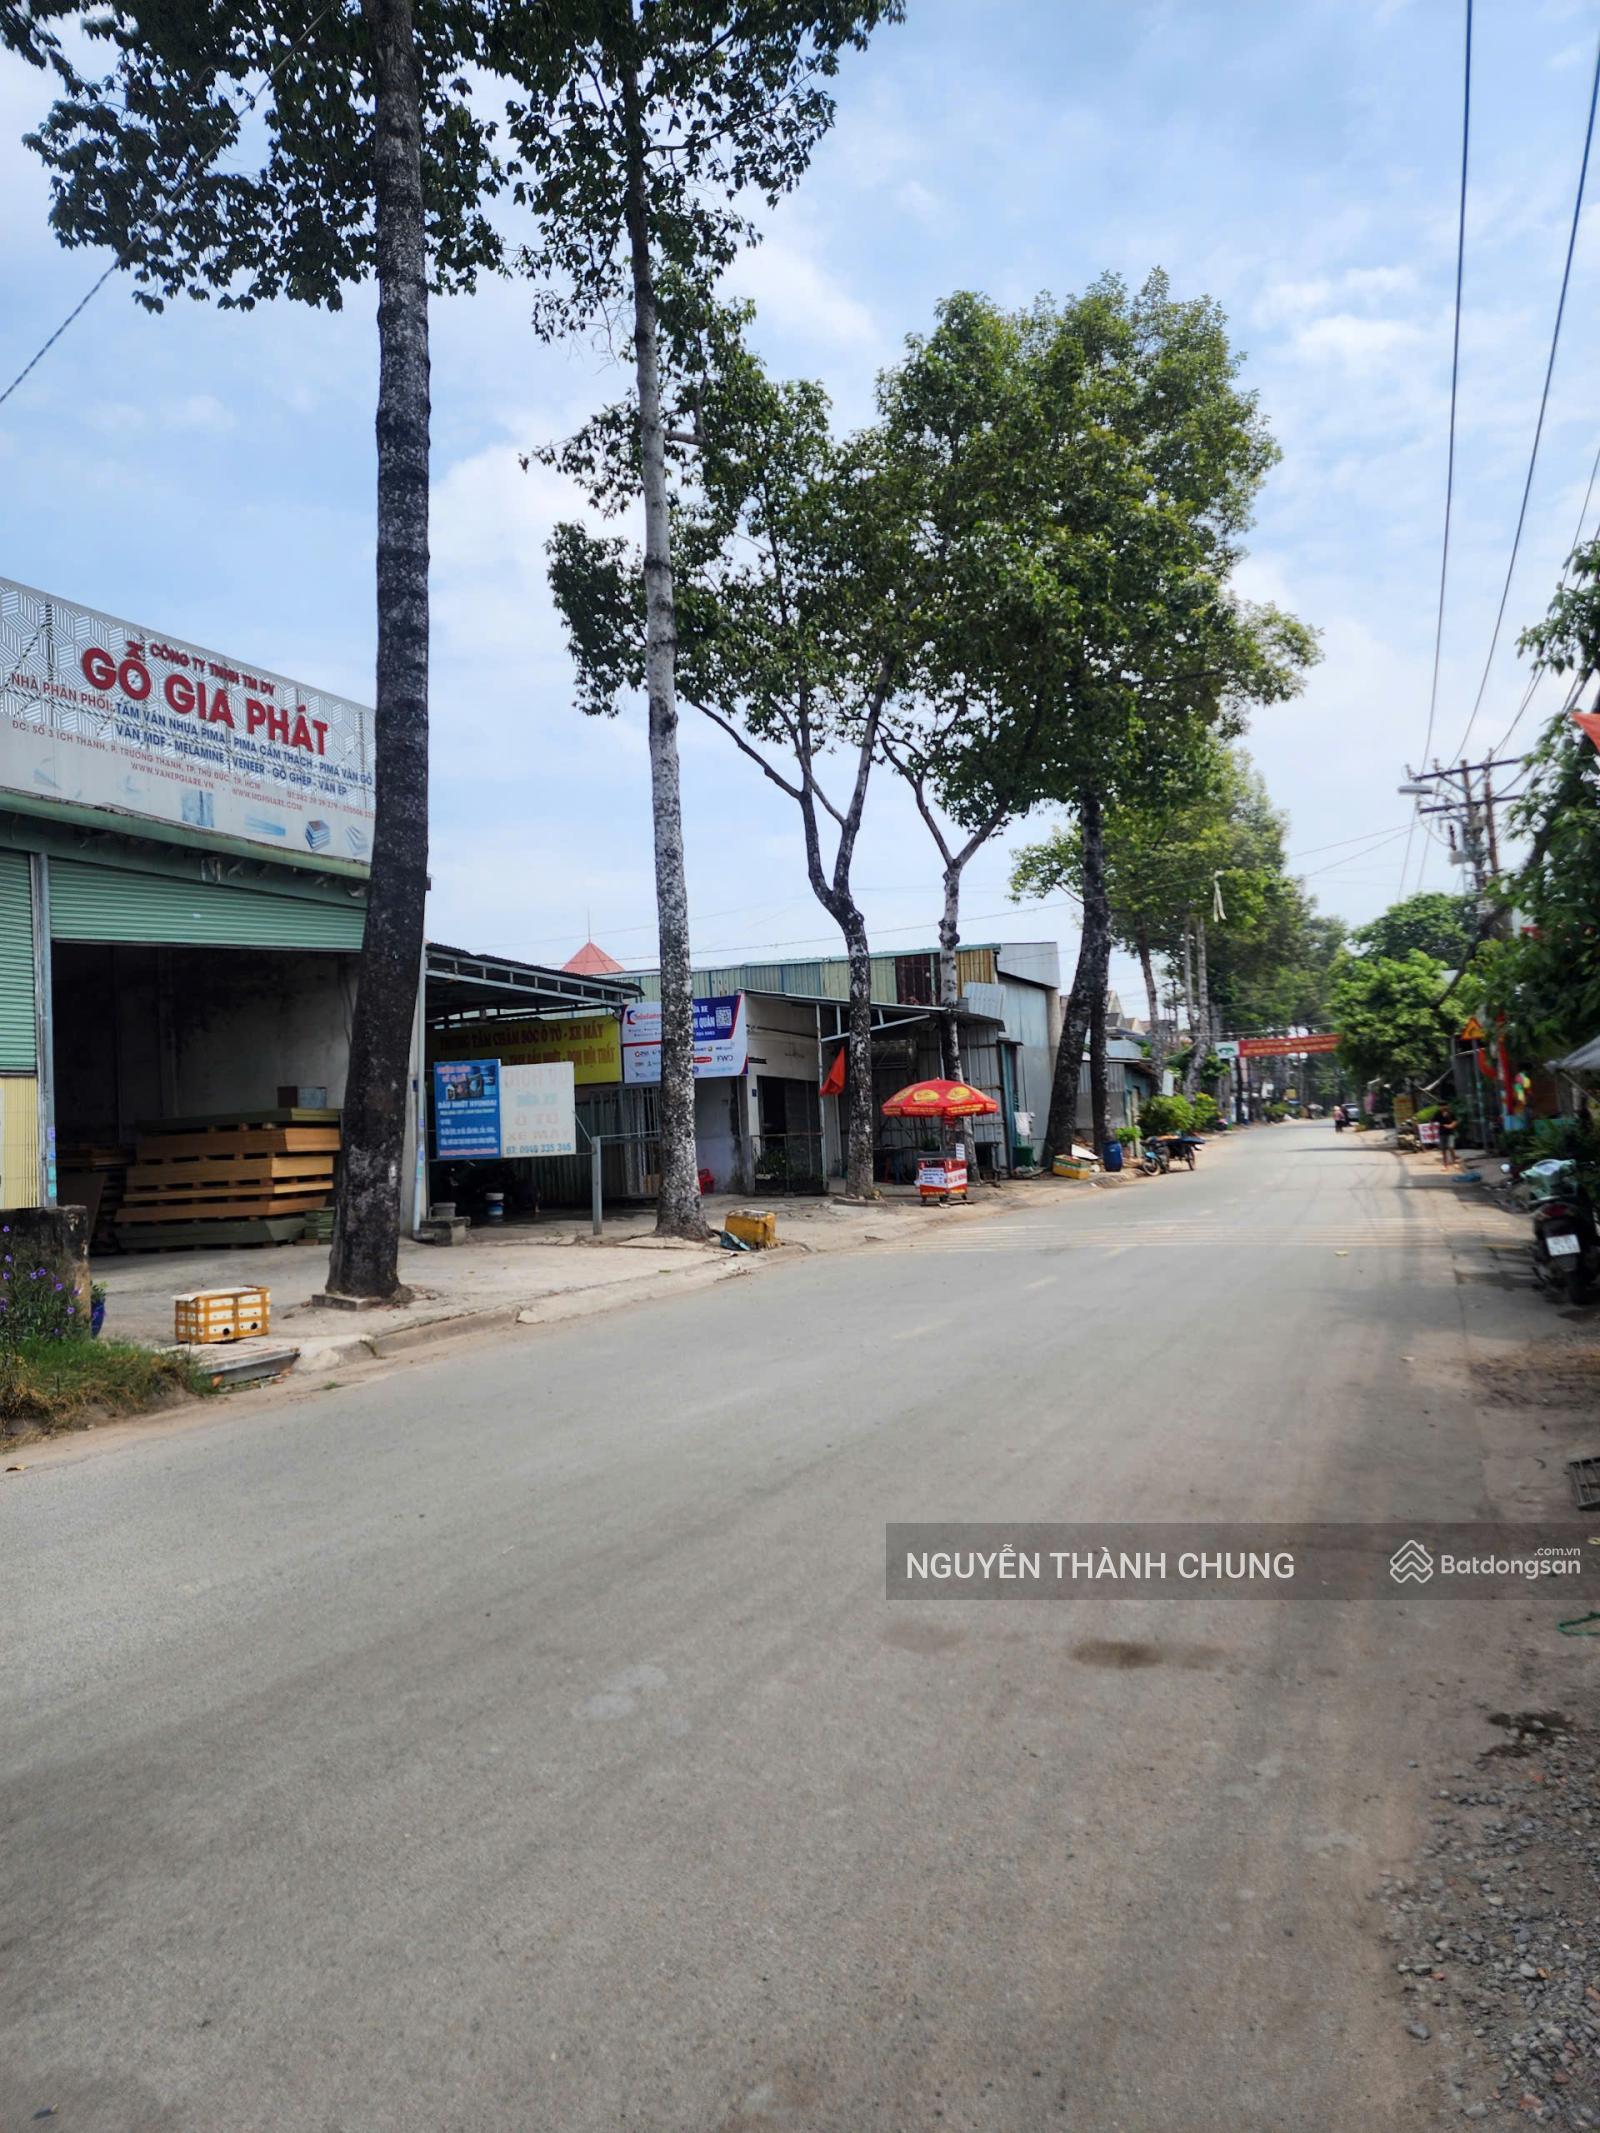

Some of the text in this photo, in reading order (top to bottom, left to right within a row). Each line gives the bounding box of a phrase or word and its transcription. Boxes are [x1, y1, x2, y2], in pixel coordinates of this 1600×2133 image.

[11, 673, 39, 690] NHÀ
[43, 682, 77, 701] PHÂN
[150, 643, 190, 667] CÔNG
[192, 657, 206, 673] TY
[208, 662, 240, 684] TNHH
[260, 680, 275, 697] DV
[81, 641, 328, 755] GỖ GIA PHÁT
[143, 731, 166, 747] MDF
[174, 740, 225, 763] MELAMINE
[233, 757, 265, 774] VENEER
[201, 728, 225, 744] PIMA
[234, 737, 257, 753] PIMA
[320, 762, 339, 777] PIMA
